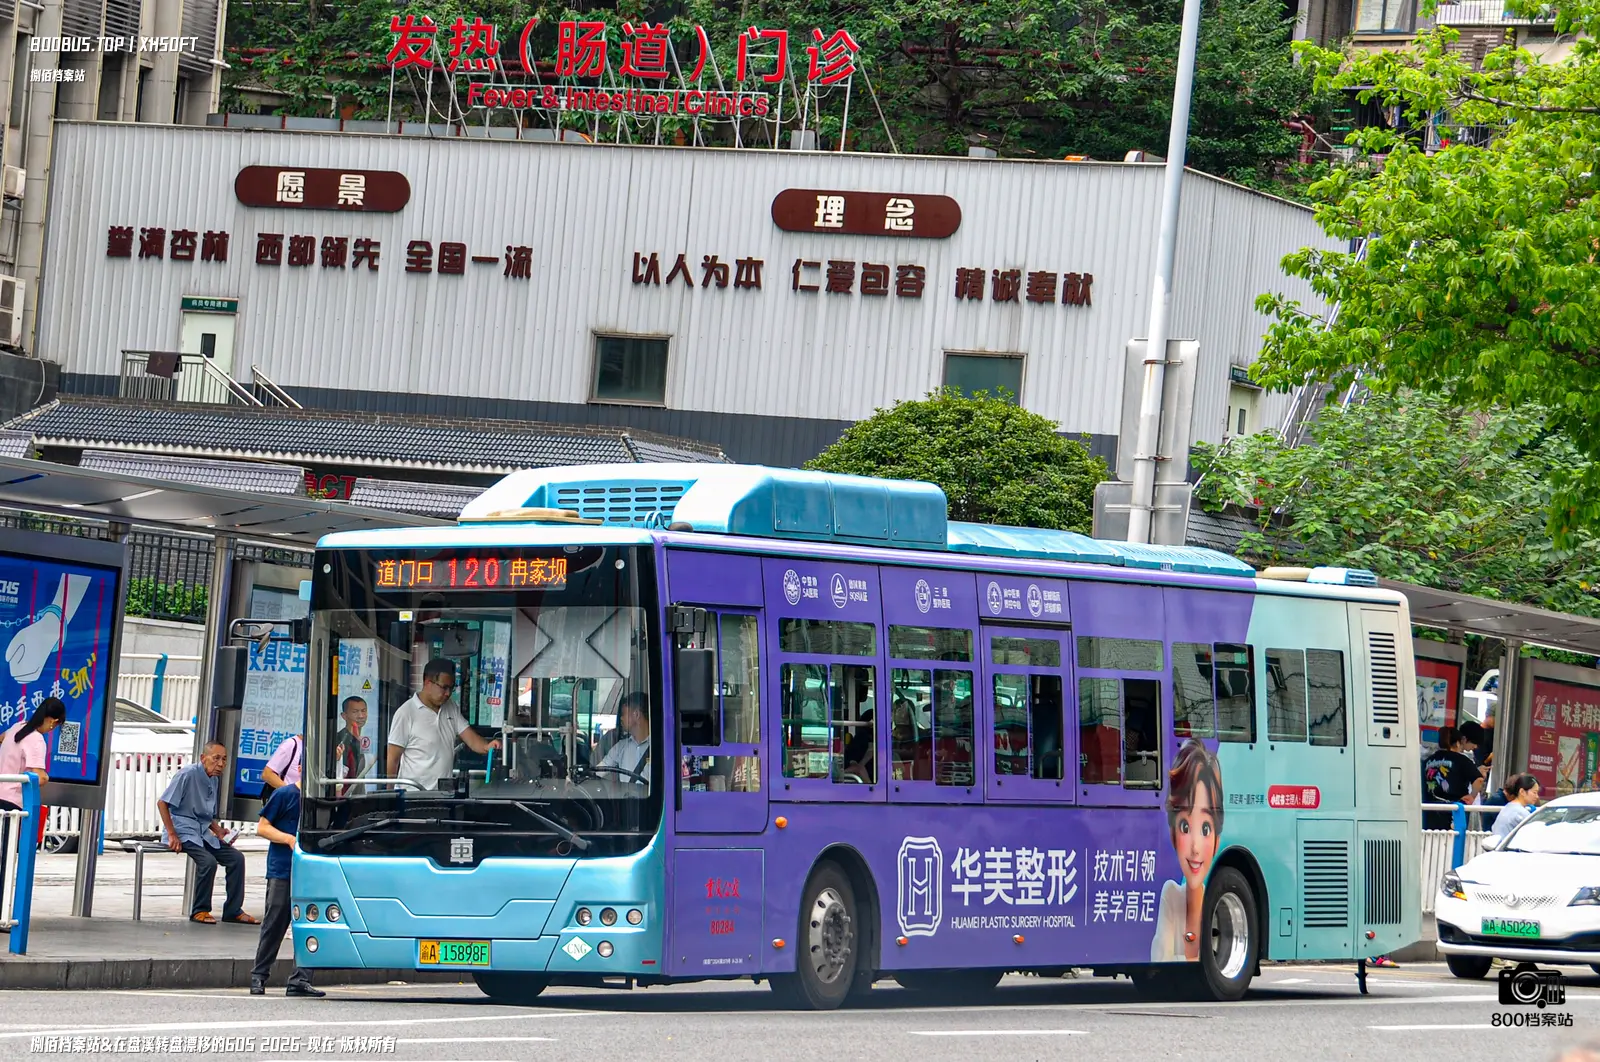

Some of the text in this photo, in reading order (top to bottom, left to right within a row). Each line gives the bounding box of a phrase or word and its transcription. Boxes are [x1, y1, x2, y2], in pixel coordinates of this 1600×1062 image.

[387, 15, 861, 86] 发热（肠道）门诊
[467, 83, 770, 115] Fever & Intestinal Clinics
[276, 171, 367, 206] 愿景
[814, 195, 915, 231] 理念
[256, 233, 380, 271] 西部领先
[405, 240, 534, 279] 全国一流
[633, 252, 1093, 306] 以人为本 仁爱包容 精诚奉献
[377, 558, 567, 587] 道门口 120 冉家坝
[951, 847, 1078, 906] 华美整形
[1093, 850, 1156, 882] 技术引领
[951, 915, 1076, 929] HUAMEI PLASTIC SURGERY HOSPITAL
[1093, 890, 1156, 923] 美学高定
[566, 943, 588, 955] CNG
